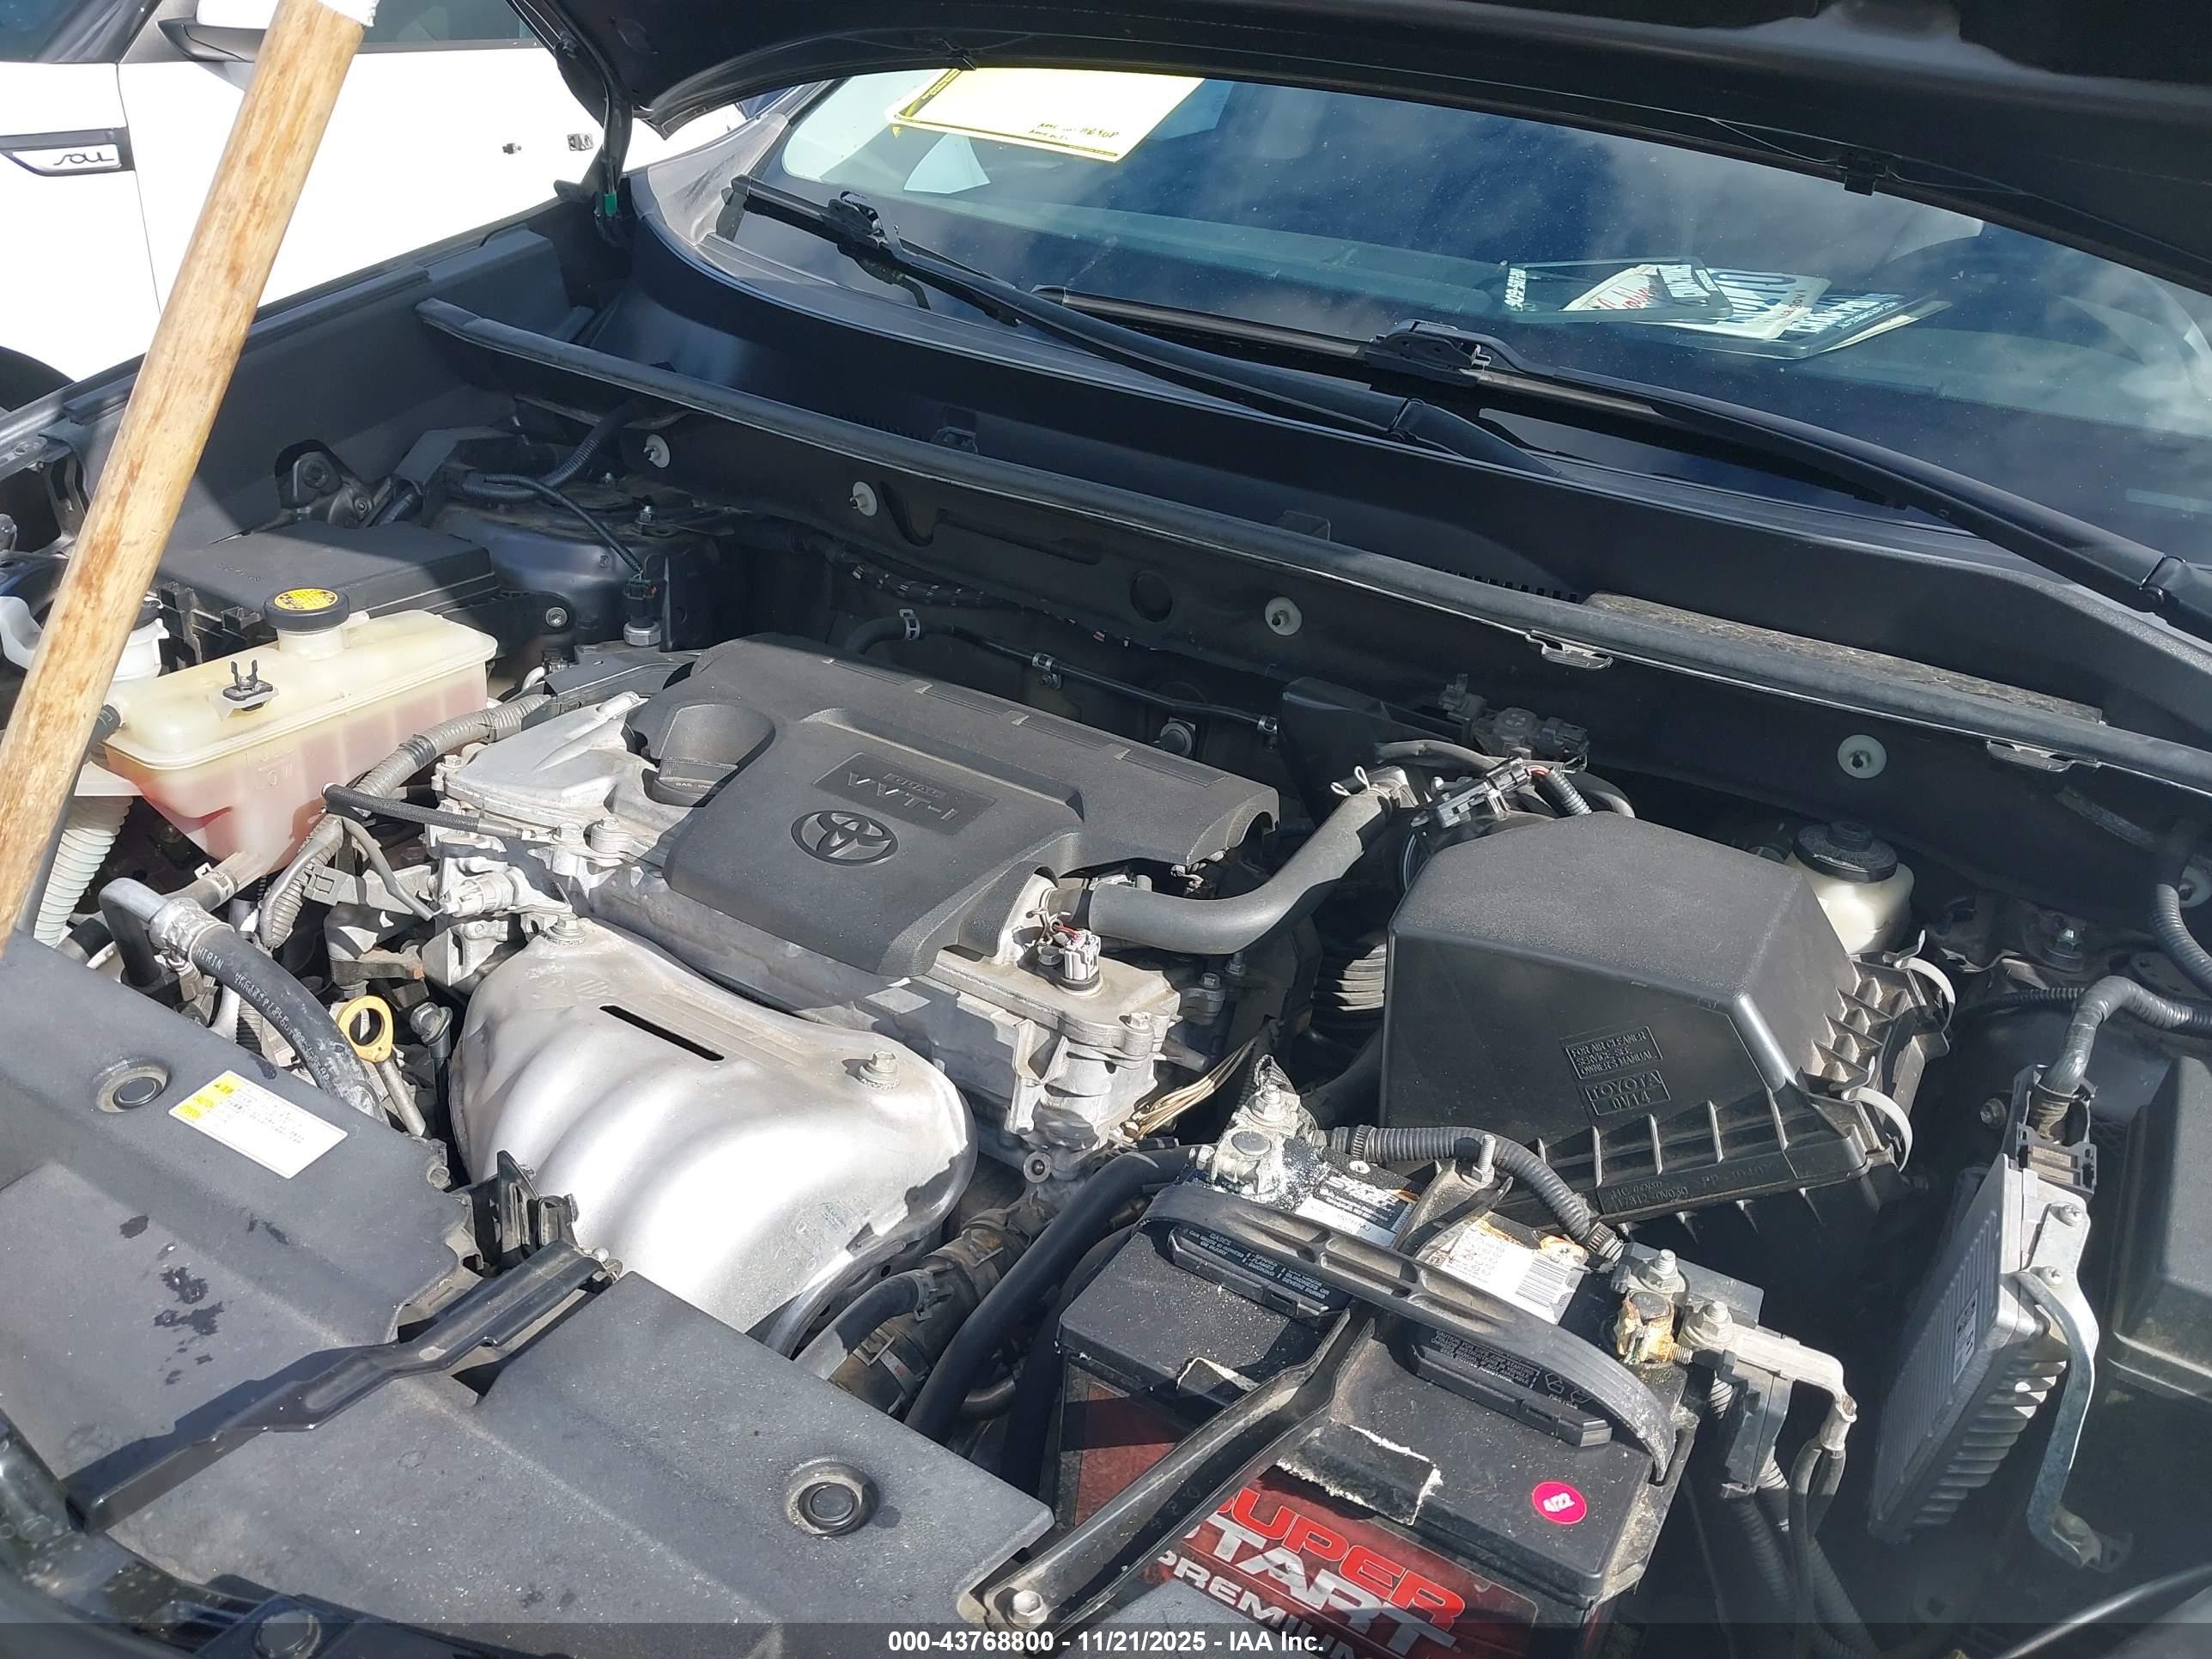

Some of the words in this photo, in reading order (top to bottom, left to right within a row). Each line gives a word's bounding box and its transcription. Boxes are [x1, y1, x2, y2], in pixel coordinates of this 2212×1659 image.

[1571, 1046, 1590, 1057] FOR
[1591, 1041, 1607, 1054] AIR
[1607, 1031, 1647, 1048] CLEANER
[1576, 1050, 1611, 1066] SERVICE
[1614, 1046, 1632, 1057] SEE
[1591, 1072, 1662, 1099] TOYOTA
[1216, 1486, 1466, 1632] UPER
[1182, 1511, 1457, 1657] TART
